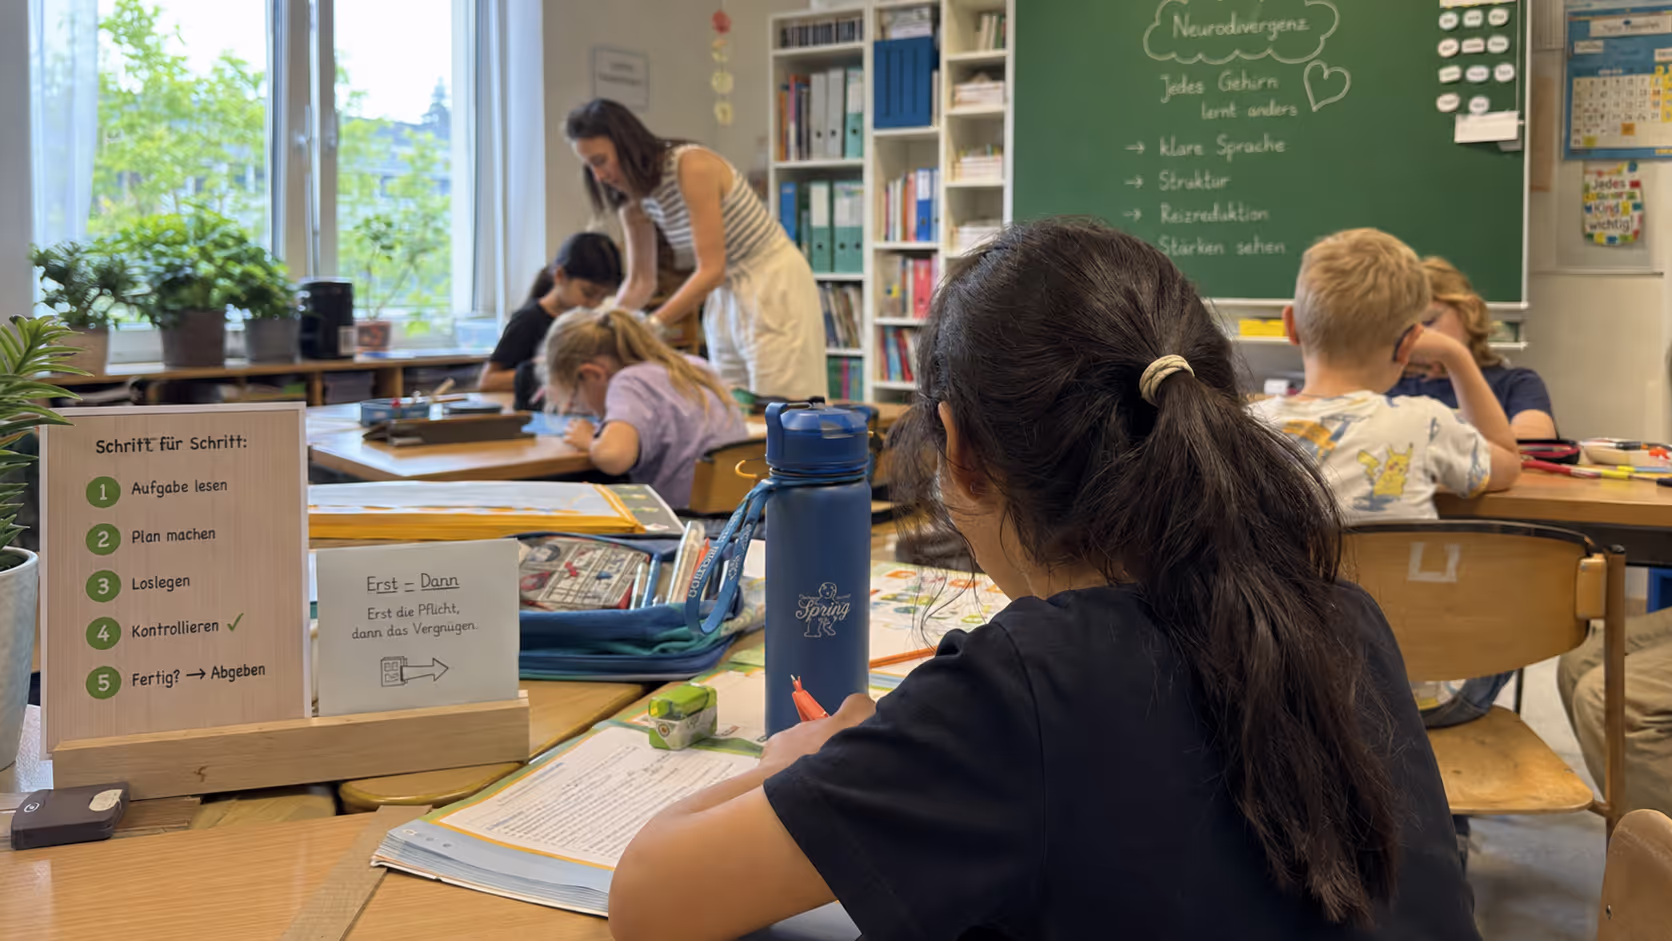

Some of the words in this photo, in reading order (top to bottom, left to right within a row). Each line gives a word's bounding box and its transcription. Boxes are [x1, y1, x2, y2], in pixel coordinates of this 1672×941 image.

[1172, 12, 1310, 41] Neurodivergenz
[1159, 74, 1205, 104] Jedes
[1217, 70, 1278, 92] Gehirn
[1201, 101, 1237, 120] lernt
[1247, 99, 1298, 118] anders
[1159, 135, 1204, 157] klare
[1216, 133, 1286, 162] Sprache
[1159, 169, 1231, 191] Struktur
[1592, 178, 1627, 191] Jedes
[1160, 202, 1269, 224] Reizreduktion
[1589, 215, 1634, 233] wichtig!
[1158, 234, 1225, 256] Stärken
[1236, 235, 1286, 256] sehen
[95, 437, 153, 455] Schritt
[159, 435, 184, 452] für
[189, 434, 248, 451] Schritt:
[99, 484, 108, 501] 1
[131, 479, 189, 499] Aufgabe
[194, 479, 228, 493] lesen
[97, 531, 110, 548] 2
[131, 529, 161, 544] Plan
[166, 527, 216, 542] machen
[97, 578, 109, 595] 3
[131, 575, 191, 593] Loslegen
[366, 575, 399, 592] Erst
[420, 572, 460, 589] Dann
[367, 607, 393, 621] Erst
[396, 606, 415, 618] die
[418, 602, 460, 616] Pflicht,
[795, 599, 850, 623] Spring
[96, 625, 110, 642] 4
[131, 620, 219, 639] Kontrollieren
[351, 627, 383, 640] dann
[386, 624, 409, 637] das
[412, 621, 479, 639] Vergnügen.
[97, 674, 110, 691] 5
[131, 668, 181, 689] Fertig?
[210, 663, 266, 683] Abgeben
